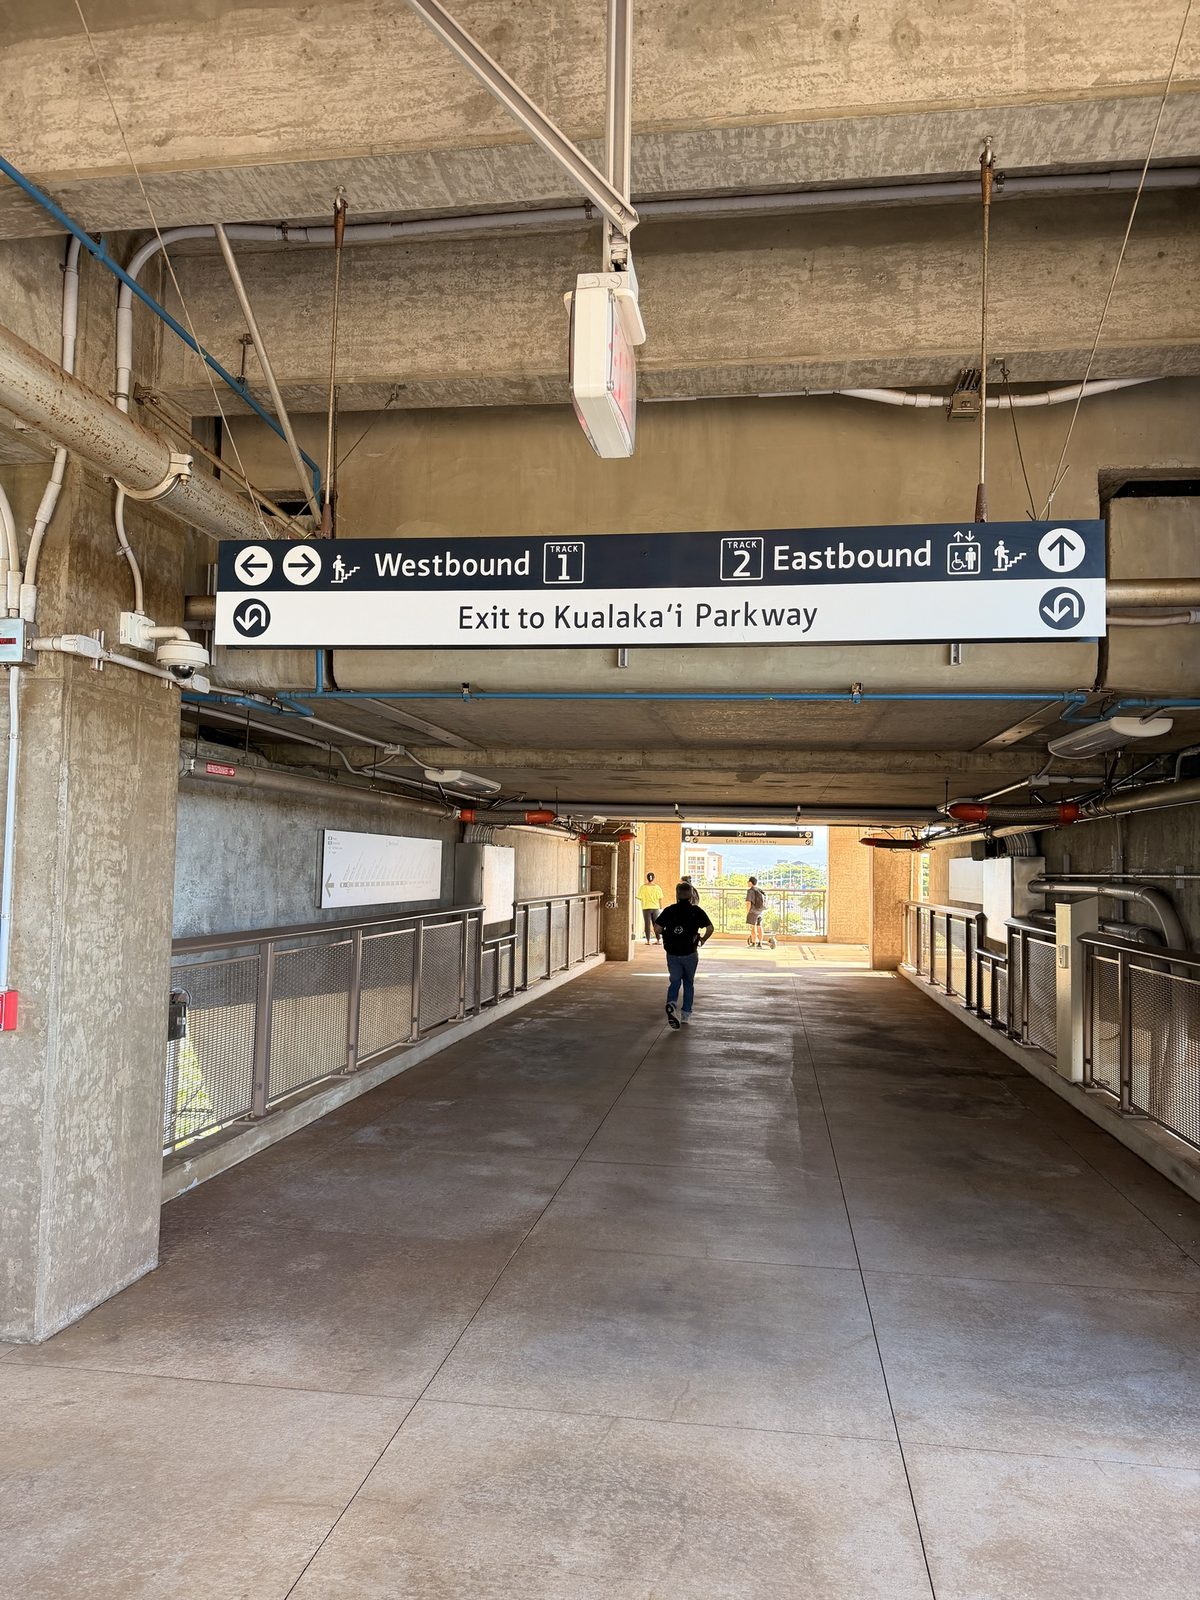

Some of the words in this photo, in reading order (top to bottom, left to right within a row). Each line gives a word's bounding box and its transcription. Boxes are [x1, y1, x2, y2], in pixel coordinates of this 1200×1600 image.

[550, 545, 579, 553] TRACK
[727, 540, 757, 549] TRACK
[774, 540, 932, 571] Eastbound
[375, 550, 530, 577] Westbound
[557, 554, 570, 581] 1
[732, 550, 752, 577] 2
[459, 604, 510, 630] Exit
[517, 607, 545, 630] to
[696, 602, 818, 633] Parkway
